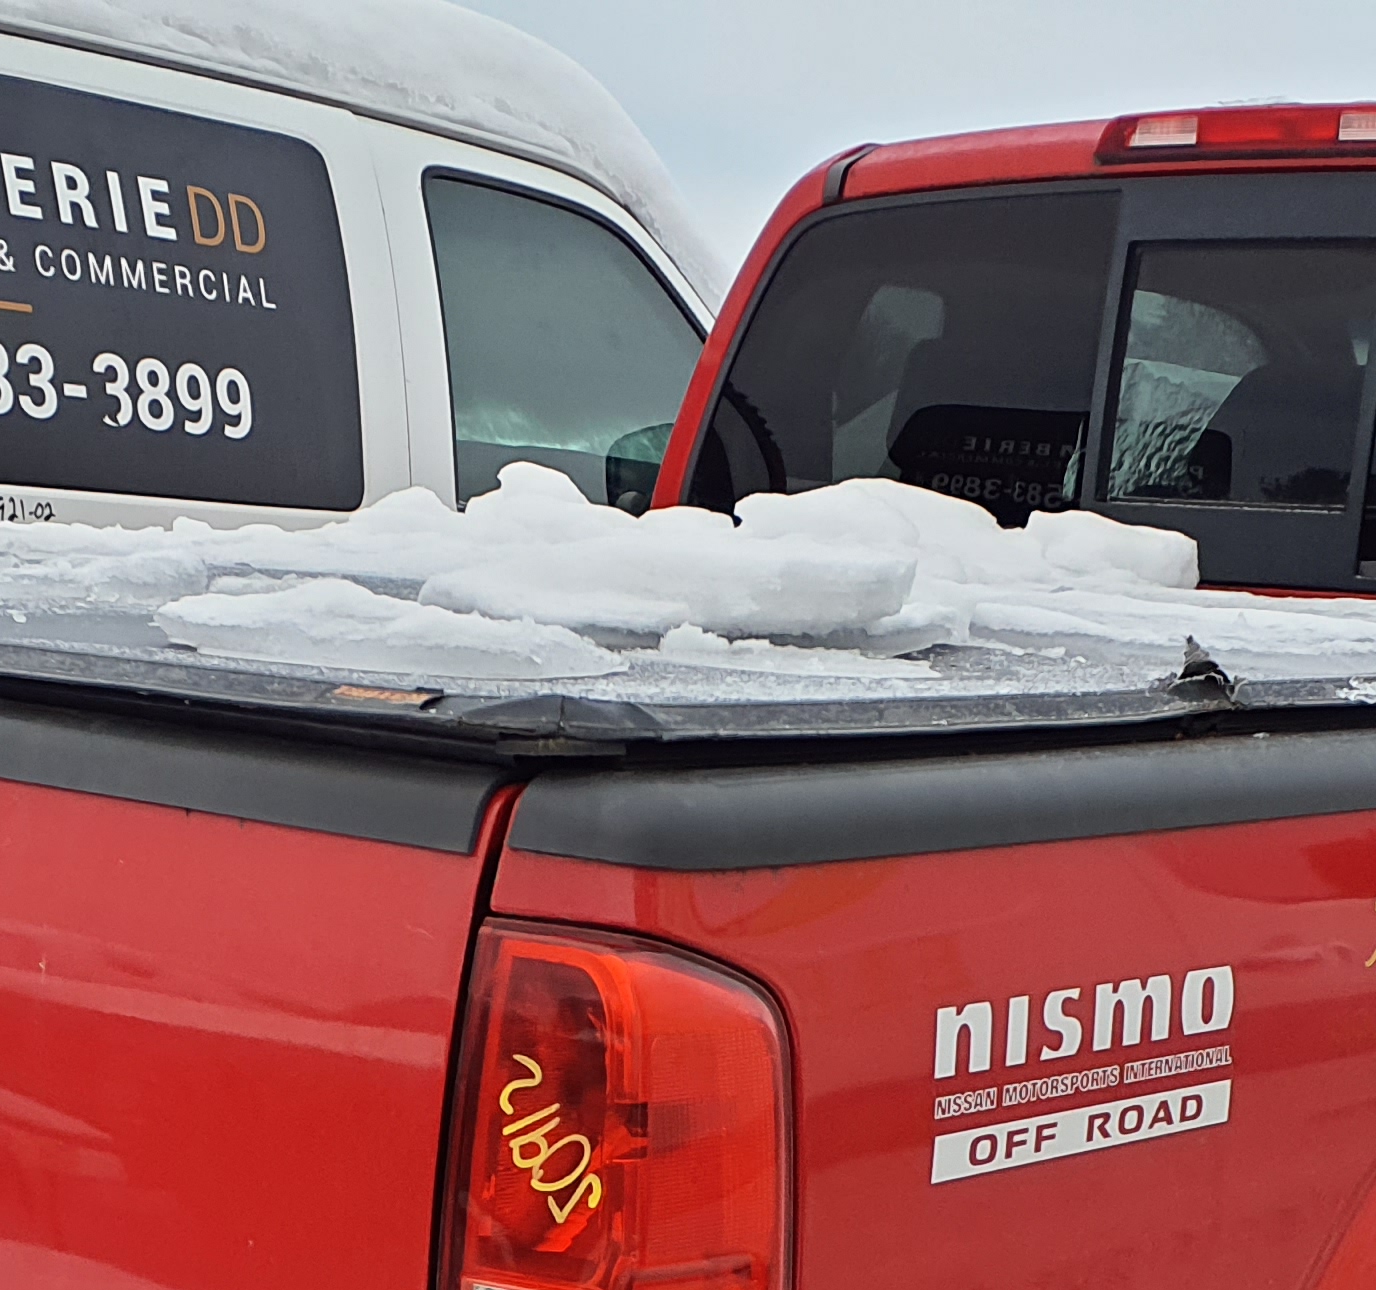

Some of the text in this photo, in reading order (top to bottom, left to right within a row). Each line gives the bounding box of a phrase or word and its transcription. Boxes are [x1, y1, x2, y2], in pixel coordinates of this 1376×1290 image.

[35, 245, 278, 310] COMMERCIAL
[934, 1045, 1233, 1120] NISSAN MOTORSPORTS INTERNATIONAL
[968, 1093, 1204, 1166] OFF ROAD
